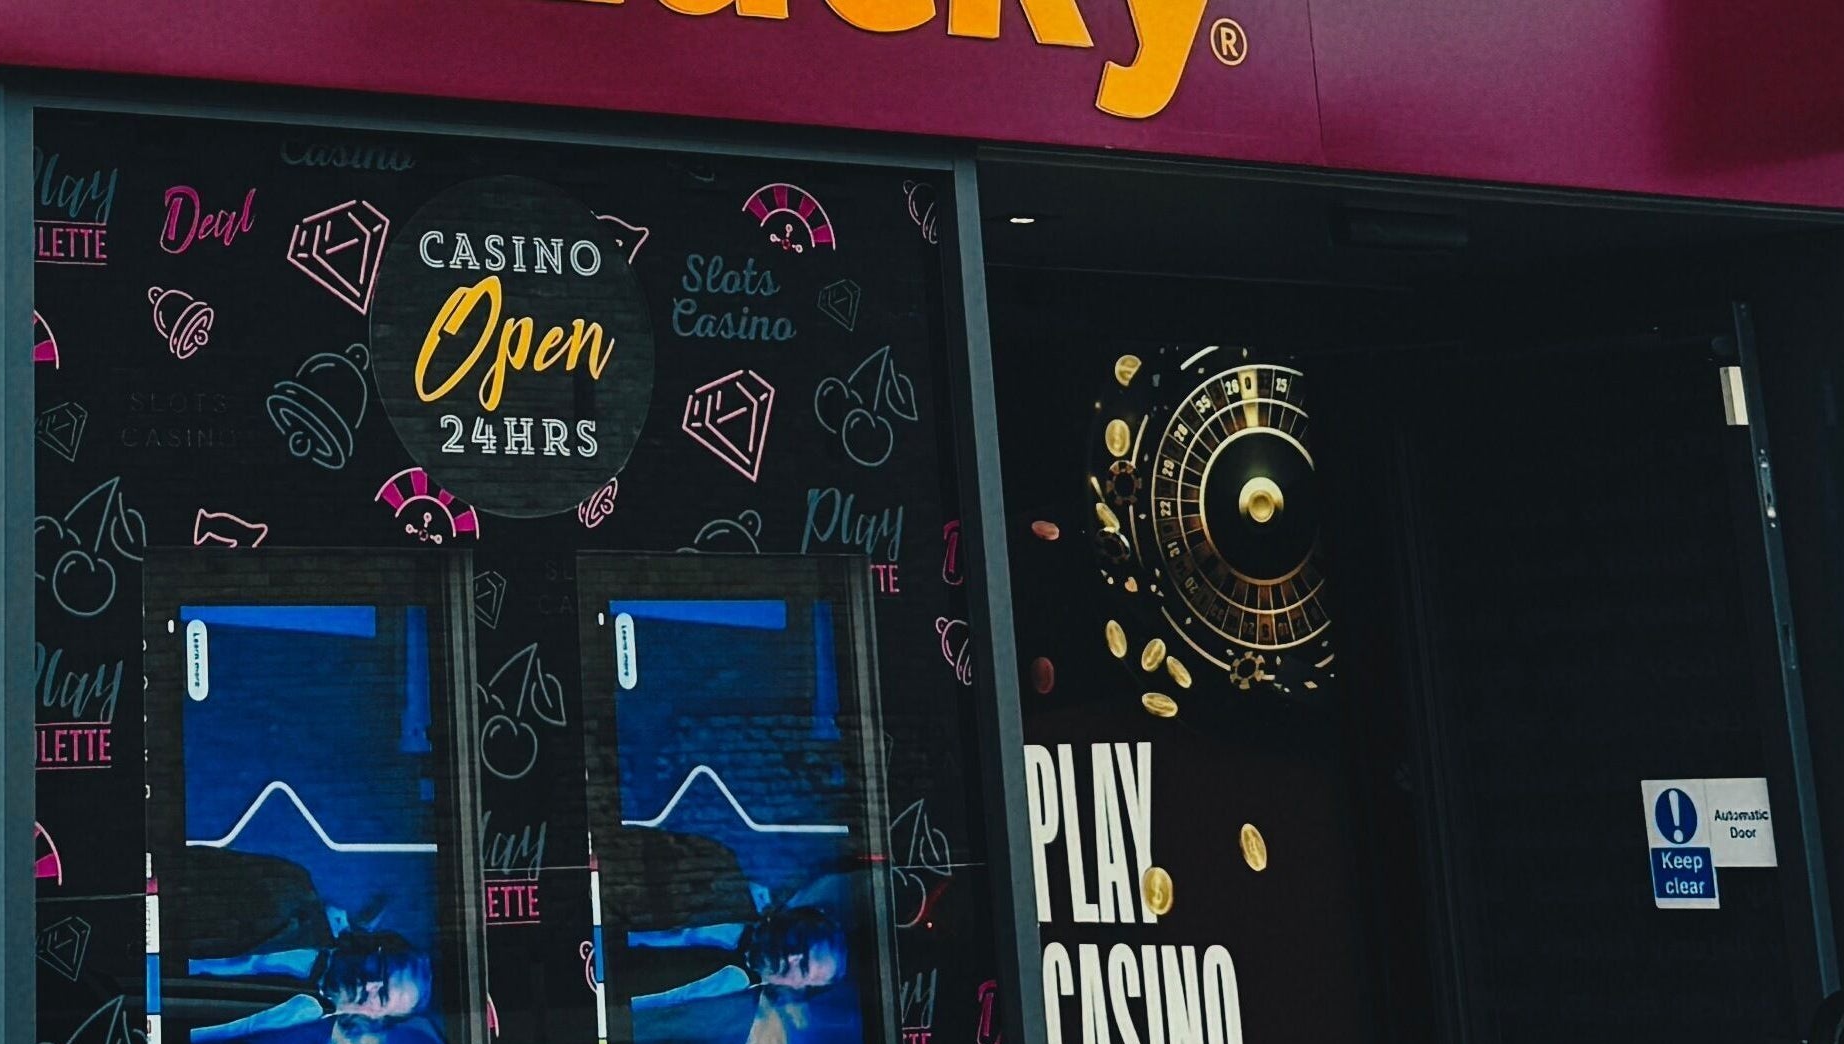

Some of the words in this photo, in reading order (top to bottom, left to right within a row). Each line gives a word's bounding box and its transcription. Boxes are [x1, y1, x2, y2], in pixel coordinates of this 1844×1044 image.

[34, 145, 119, 225] lay
[37, 225, 108, 259] LETTE
[159, 184, 257, 255] Deal
[419, 230, 602, 277] CASINO
[680, 253, 782, 297] Slots
[413, 274, 616, 412] Open
[671, 297, 798, 343] Casino
[439, 413, 599, 459] 24HRS
[799, 487, 904, 562] Play
[35, 641, 124, 723] lay
[40, 728, 113, 764] LETTE
[1022, 740, 1159, 926] PLAY
[1714, 808, 1770, 822] Automatic
[1729, 826, 1757, 839] Door
[1661, 851, 1704, 874] Keep
[1665, 876, 1706, 895] clear
[486, 885, 541, 919] ETTE
